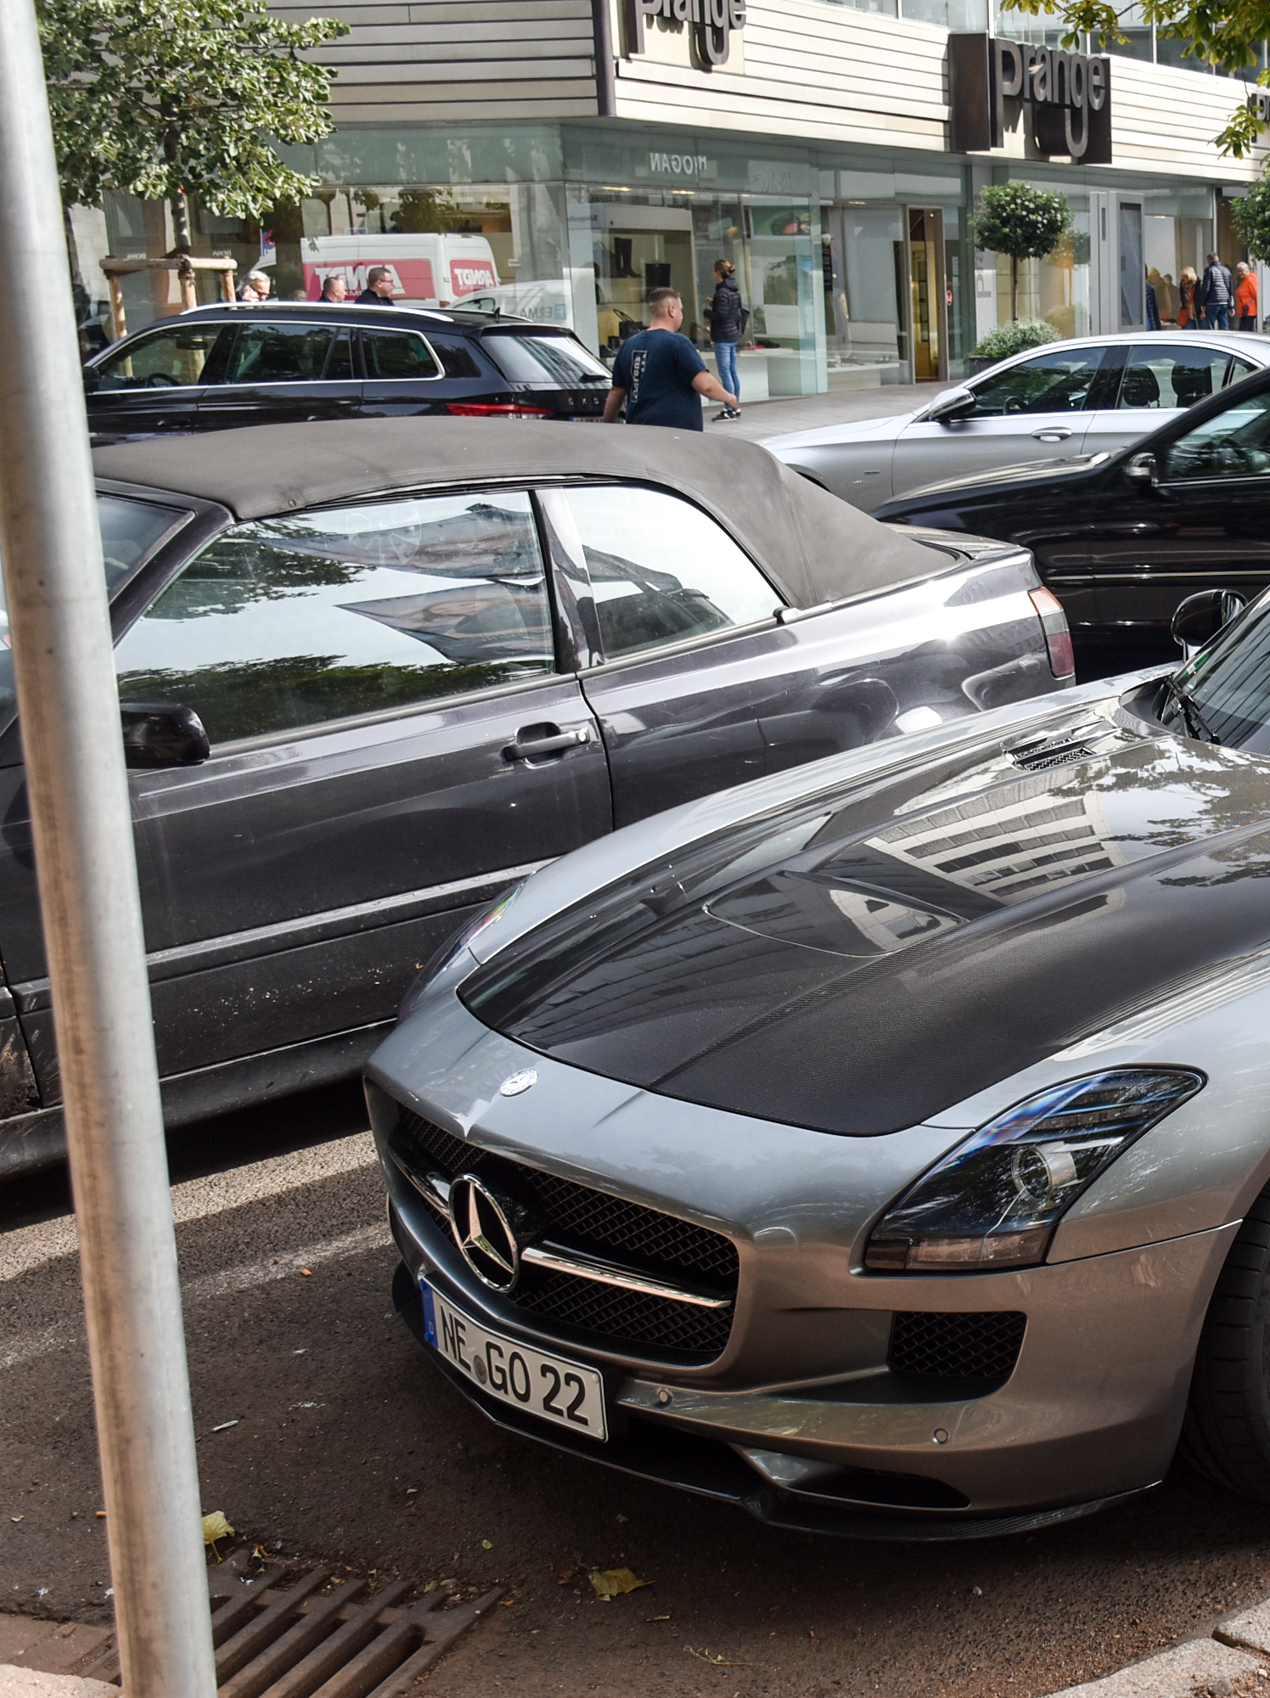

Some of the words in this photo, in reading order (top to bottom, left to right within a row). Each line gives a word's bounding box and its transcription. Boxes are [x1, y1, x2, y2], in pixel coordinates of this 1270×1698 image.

[995, 38, 1106, 158] prange
[440, 1305, 472, 1373] NE
[485, 1340, 531, 1403] GO
[540, 1363, 589, 1427] 22
